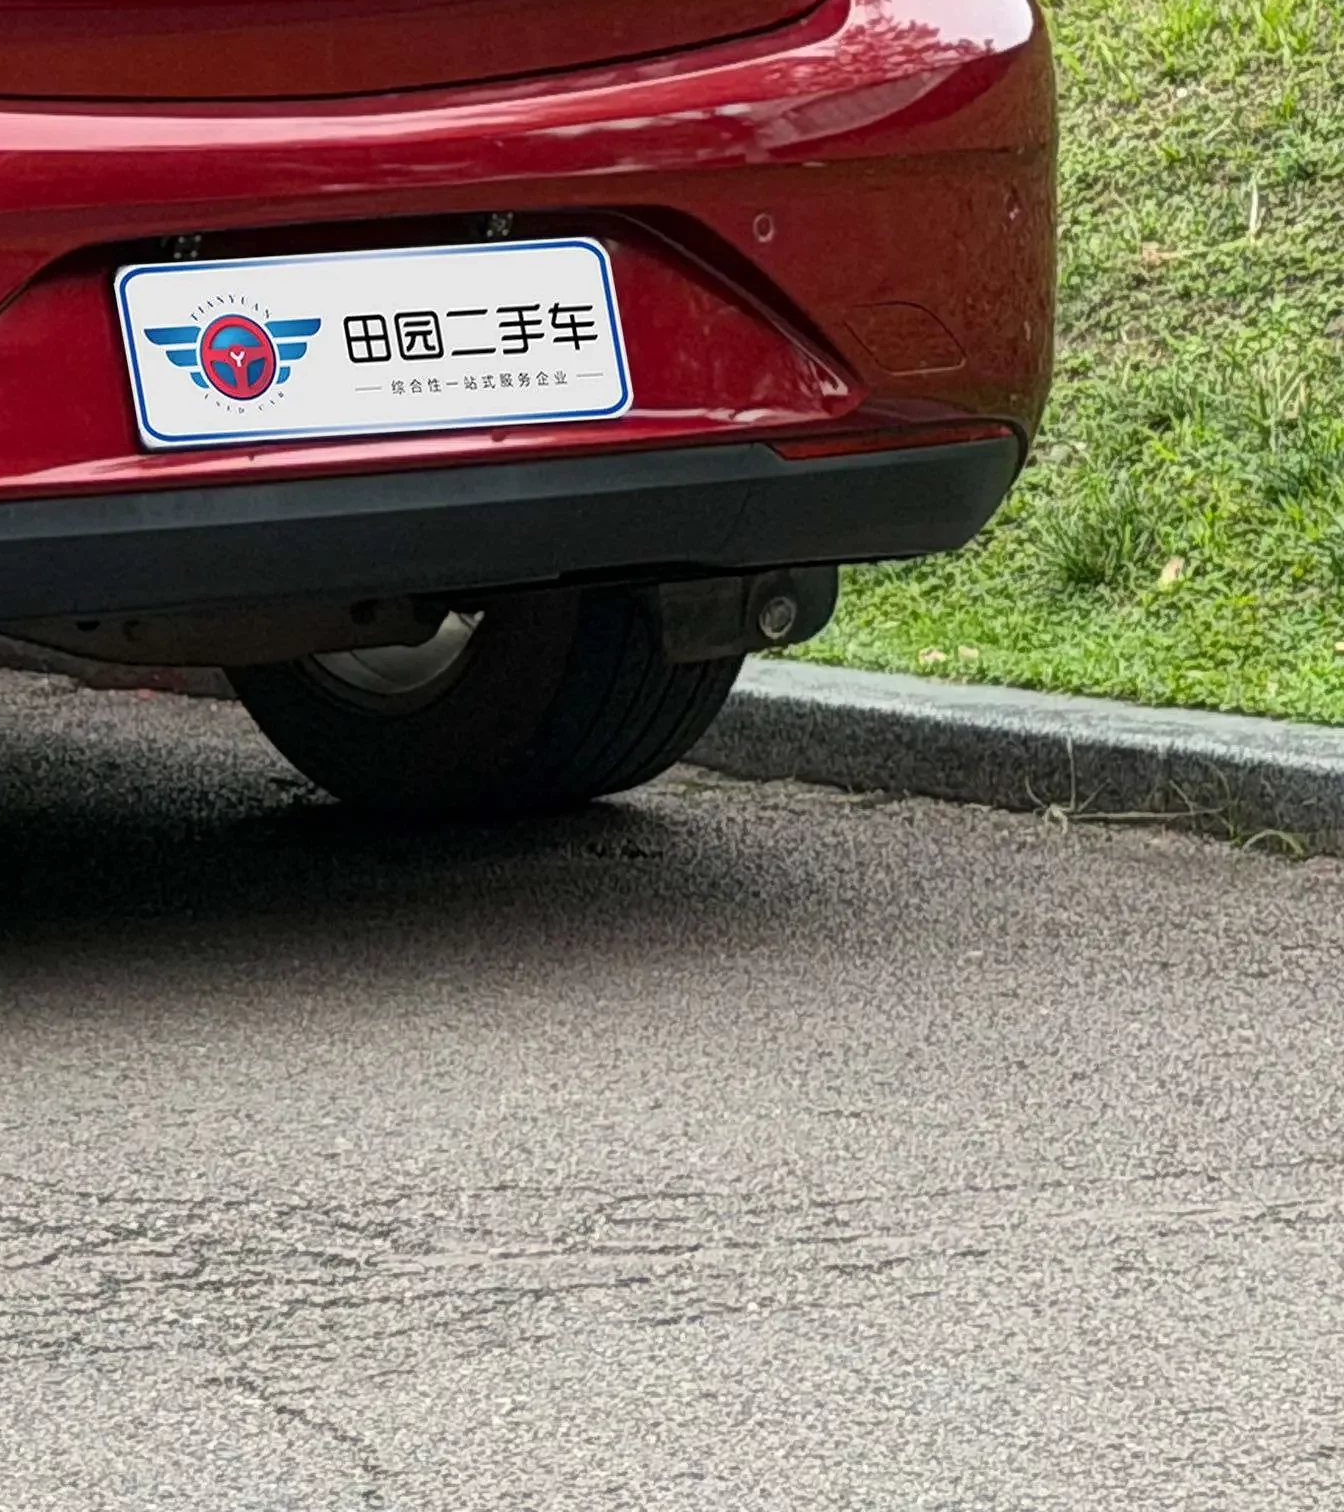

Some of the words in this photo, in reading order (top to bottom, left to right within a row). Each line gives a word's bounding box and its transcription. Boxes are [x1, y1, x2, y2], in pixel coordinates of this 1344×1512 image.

[342, 302, 600, 364] 田园二手车
[390, 370, 568, 395] 综合性一站式服务企业
